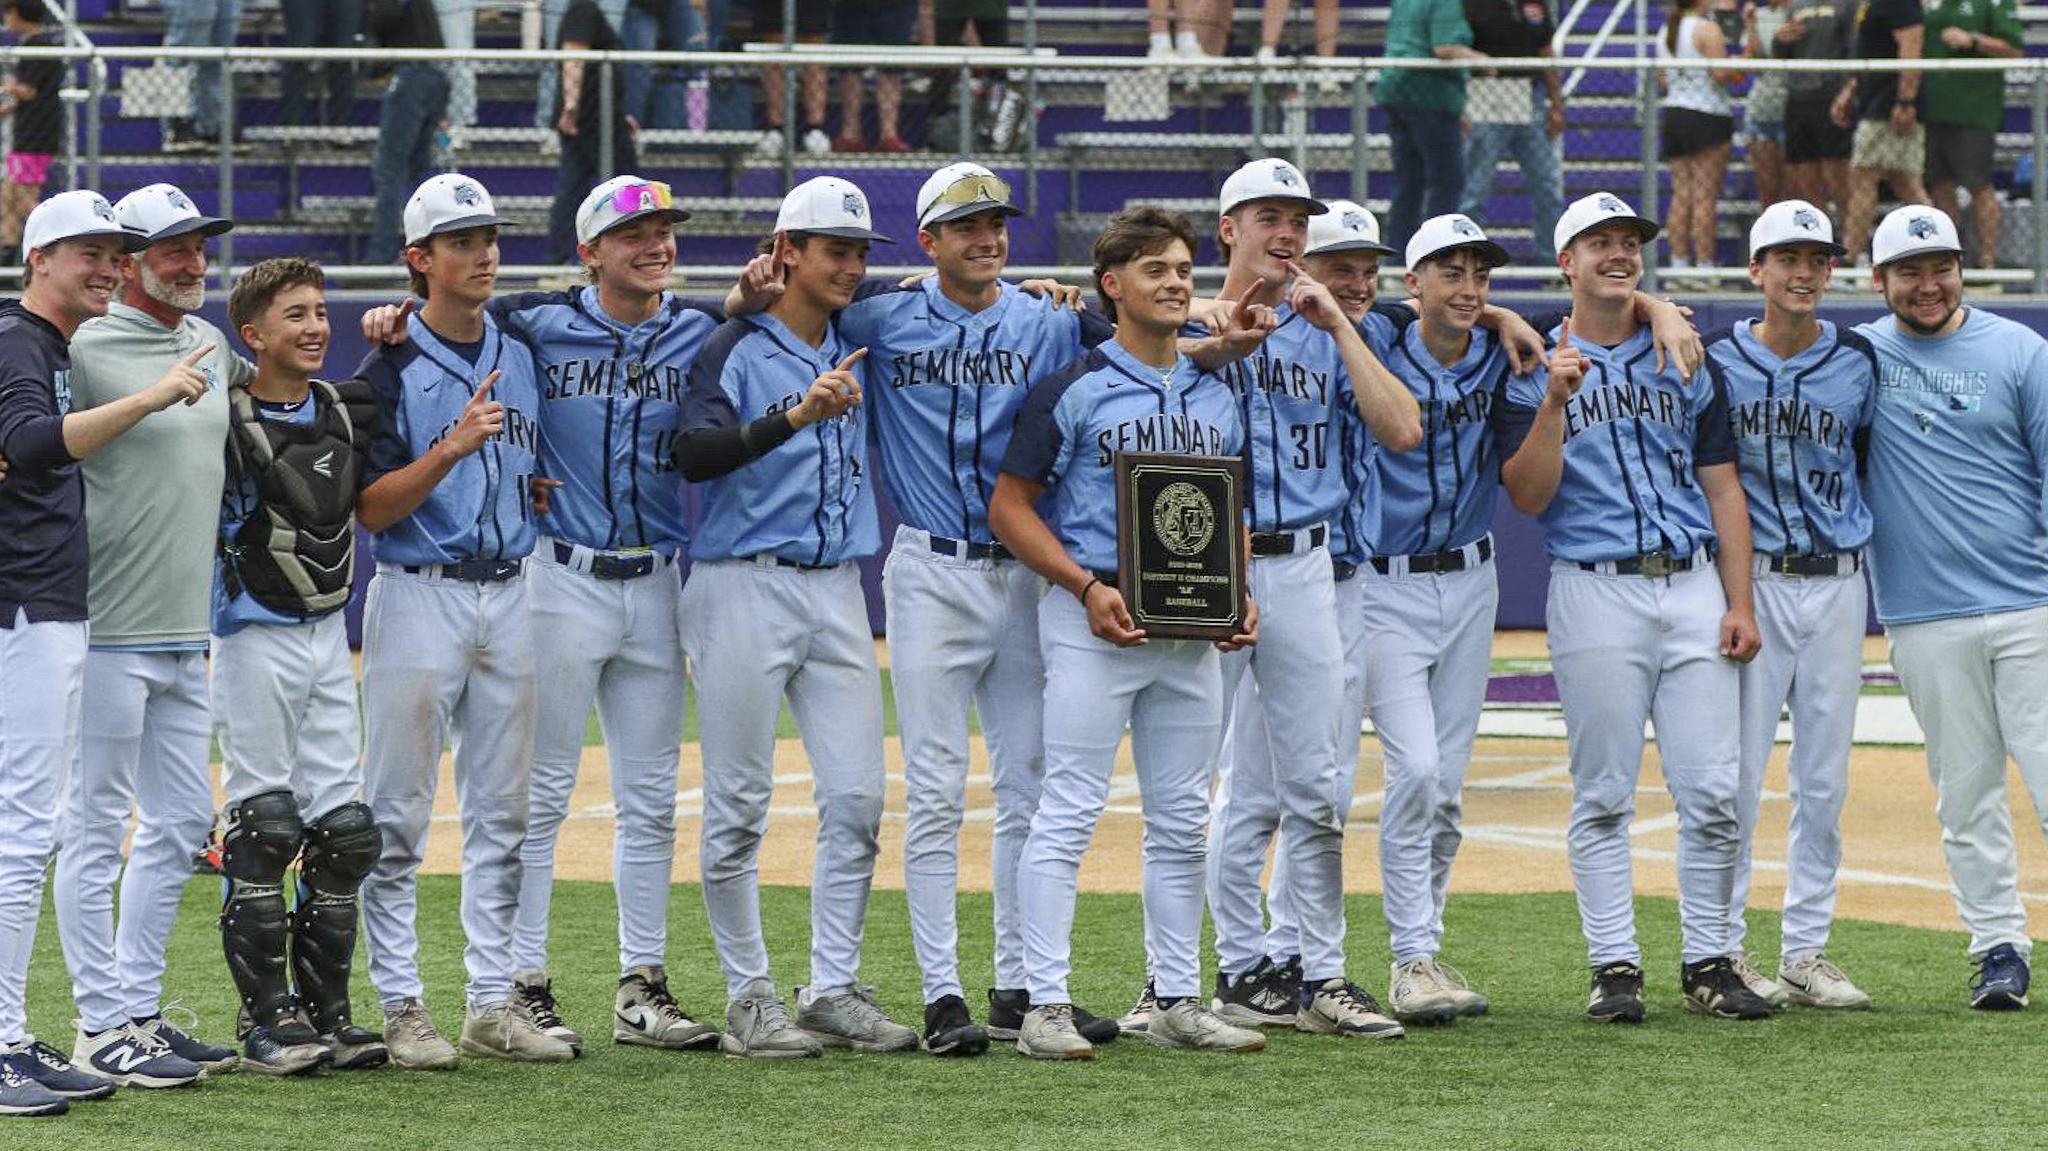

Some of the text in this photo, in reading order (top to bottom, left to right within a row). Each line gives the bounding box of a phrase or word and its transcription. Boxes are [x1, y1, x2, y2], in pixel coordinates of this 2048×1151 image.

[545, 358, 692, 406] SEMINAR
[893, 348, 1032, 392] SEMINARY
[1563, 384, 1688, 443] EMINARY
[1290, 420, 1330, 471] 30
